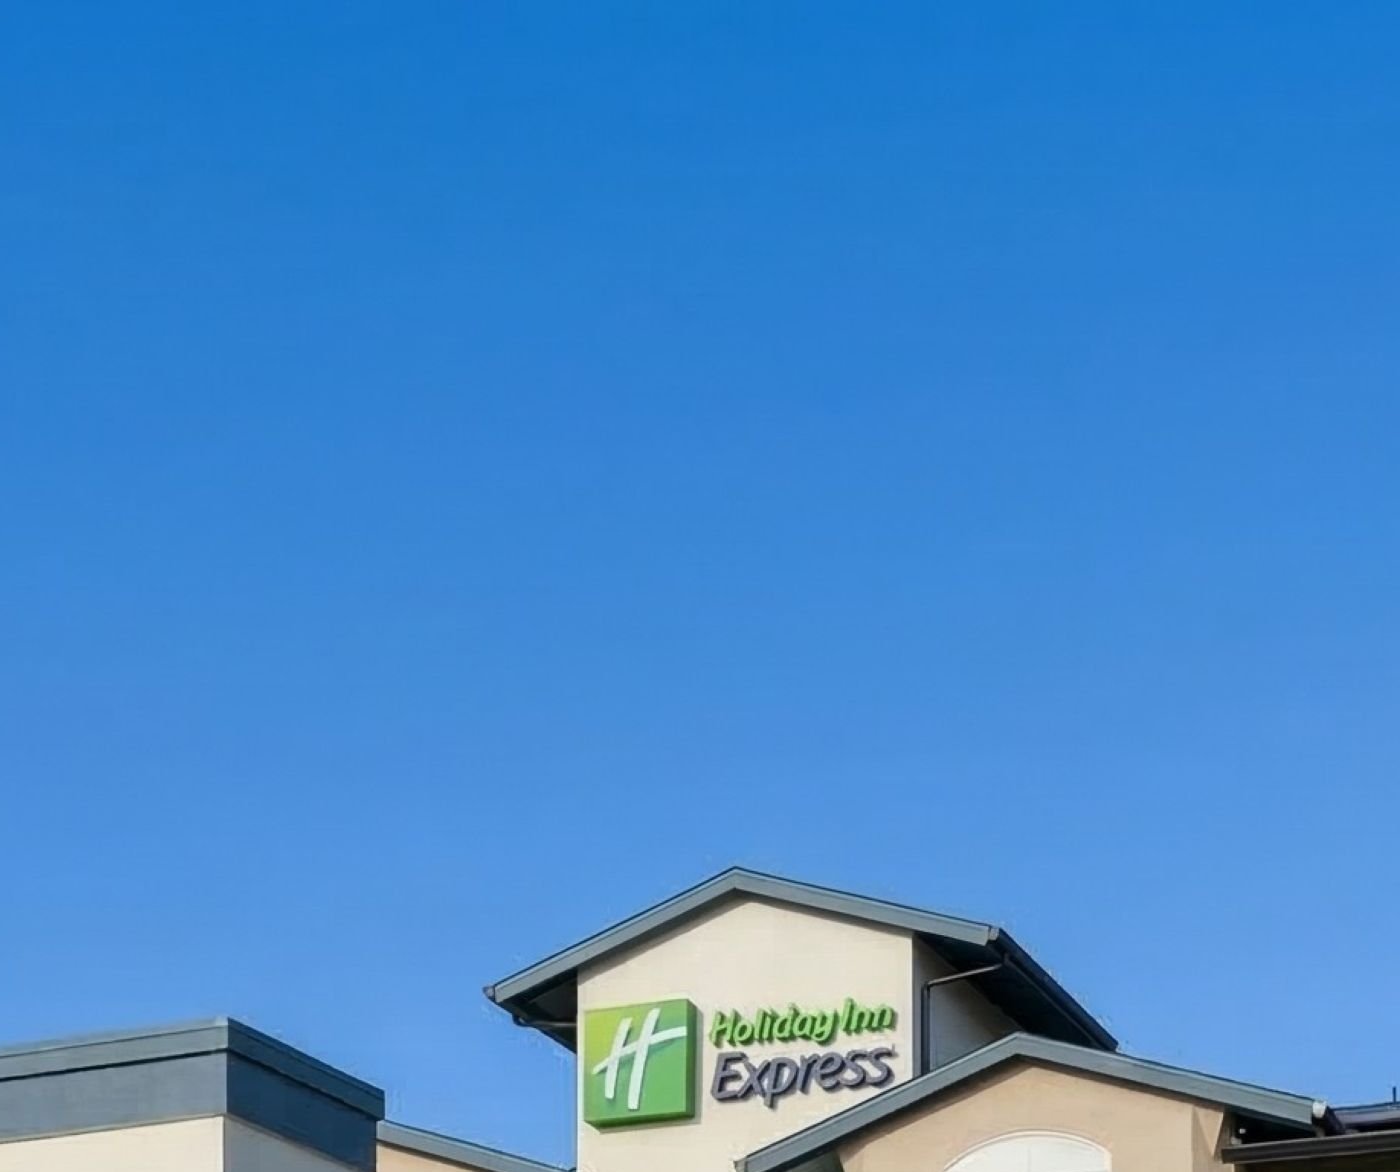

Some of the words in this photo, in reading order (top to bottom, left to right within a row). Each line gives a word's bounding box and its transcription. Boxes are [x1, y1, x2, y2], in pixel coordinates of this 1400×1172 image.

[711, 1003, 835, 1045] Holiday
[840, 998, 896, 1034] Inn
[593, 1007, 688, 1110] H
[710, 1046, 897, 1107] Express
